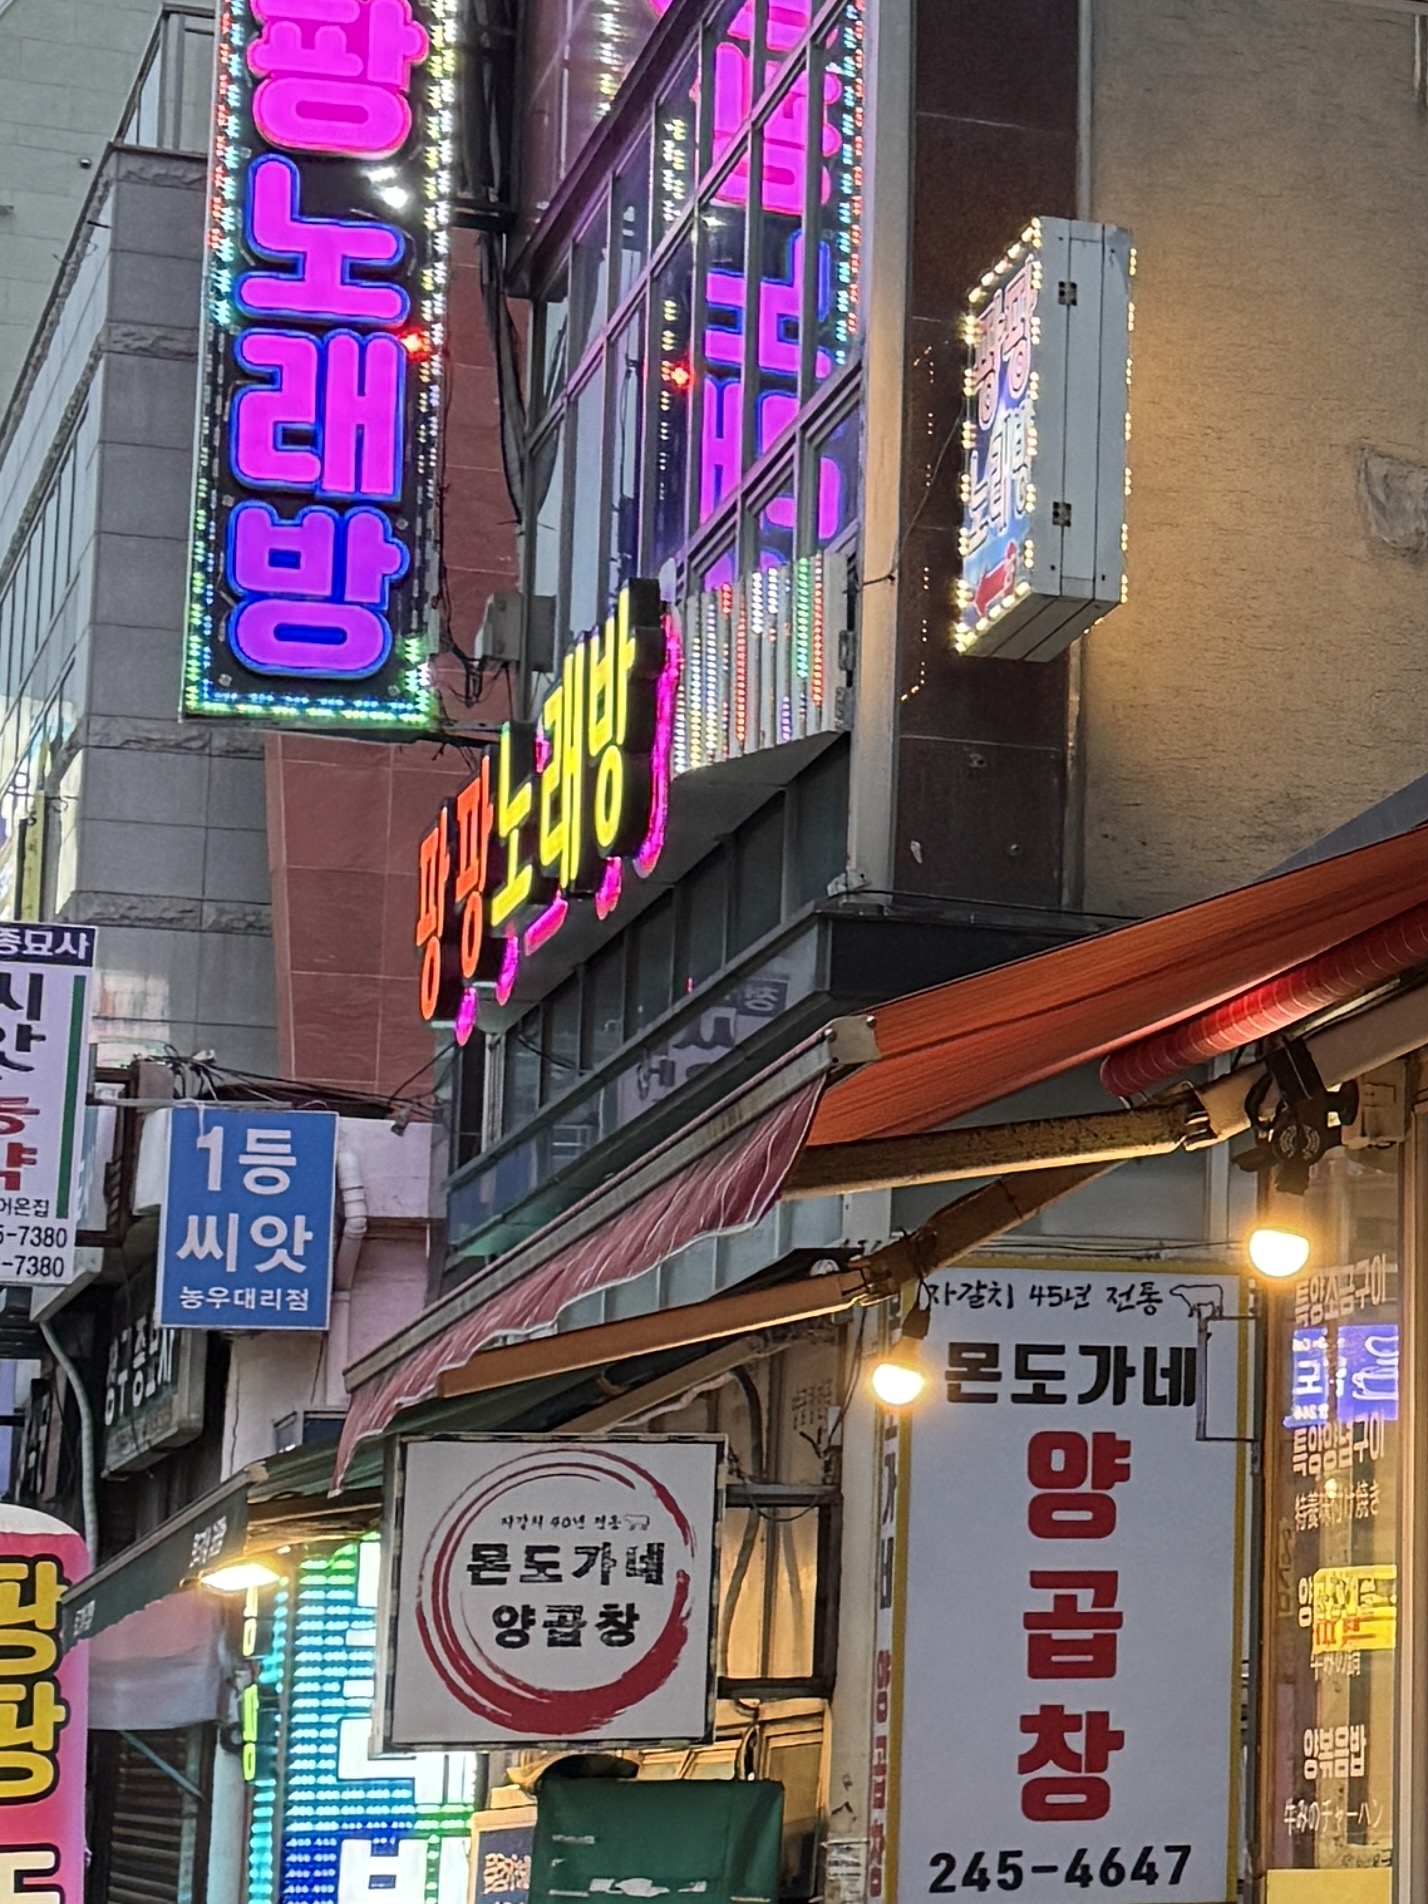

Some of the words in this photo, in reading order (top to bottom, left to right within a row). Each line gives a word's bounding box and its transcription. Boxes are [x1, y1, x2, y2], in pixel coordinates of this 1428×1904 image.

[196, 1125, 297, 1197] 1등
[0, 1254, 64, 1279] -7380
[175, 1213, 314, 1276] 씨앗
[179, 1285, 310, 1313] 농우대리점
[920, 1281, 1016, 1310] 자갈치
[1028, 1283, 1091, 1311] 45년
[1105, 1281, 1165, 1316] 전통
[943, 1341, 1199, 1409] 몬도가네
[466, 1541, 666, 1586] 몬도가네
[492, 1602, 641, 1650] 양곱창
[1017, 1430, 1133, 1823] 양곱창
[1303, 1723, 1368, 1781] 양볶음밥
[928, 1844, 1193, 1895] 245-4647
